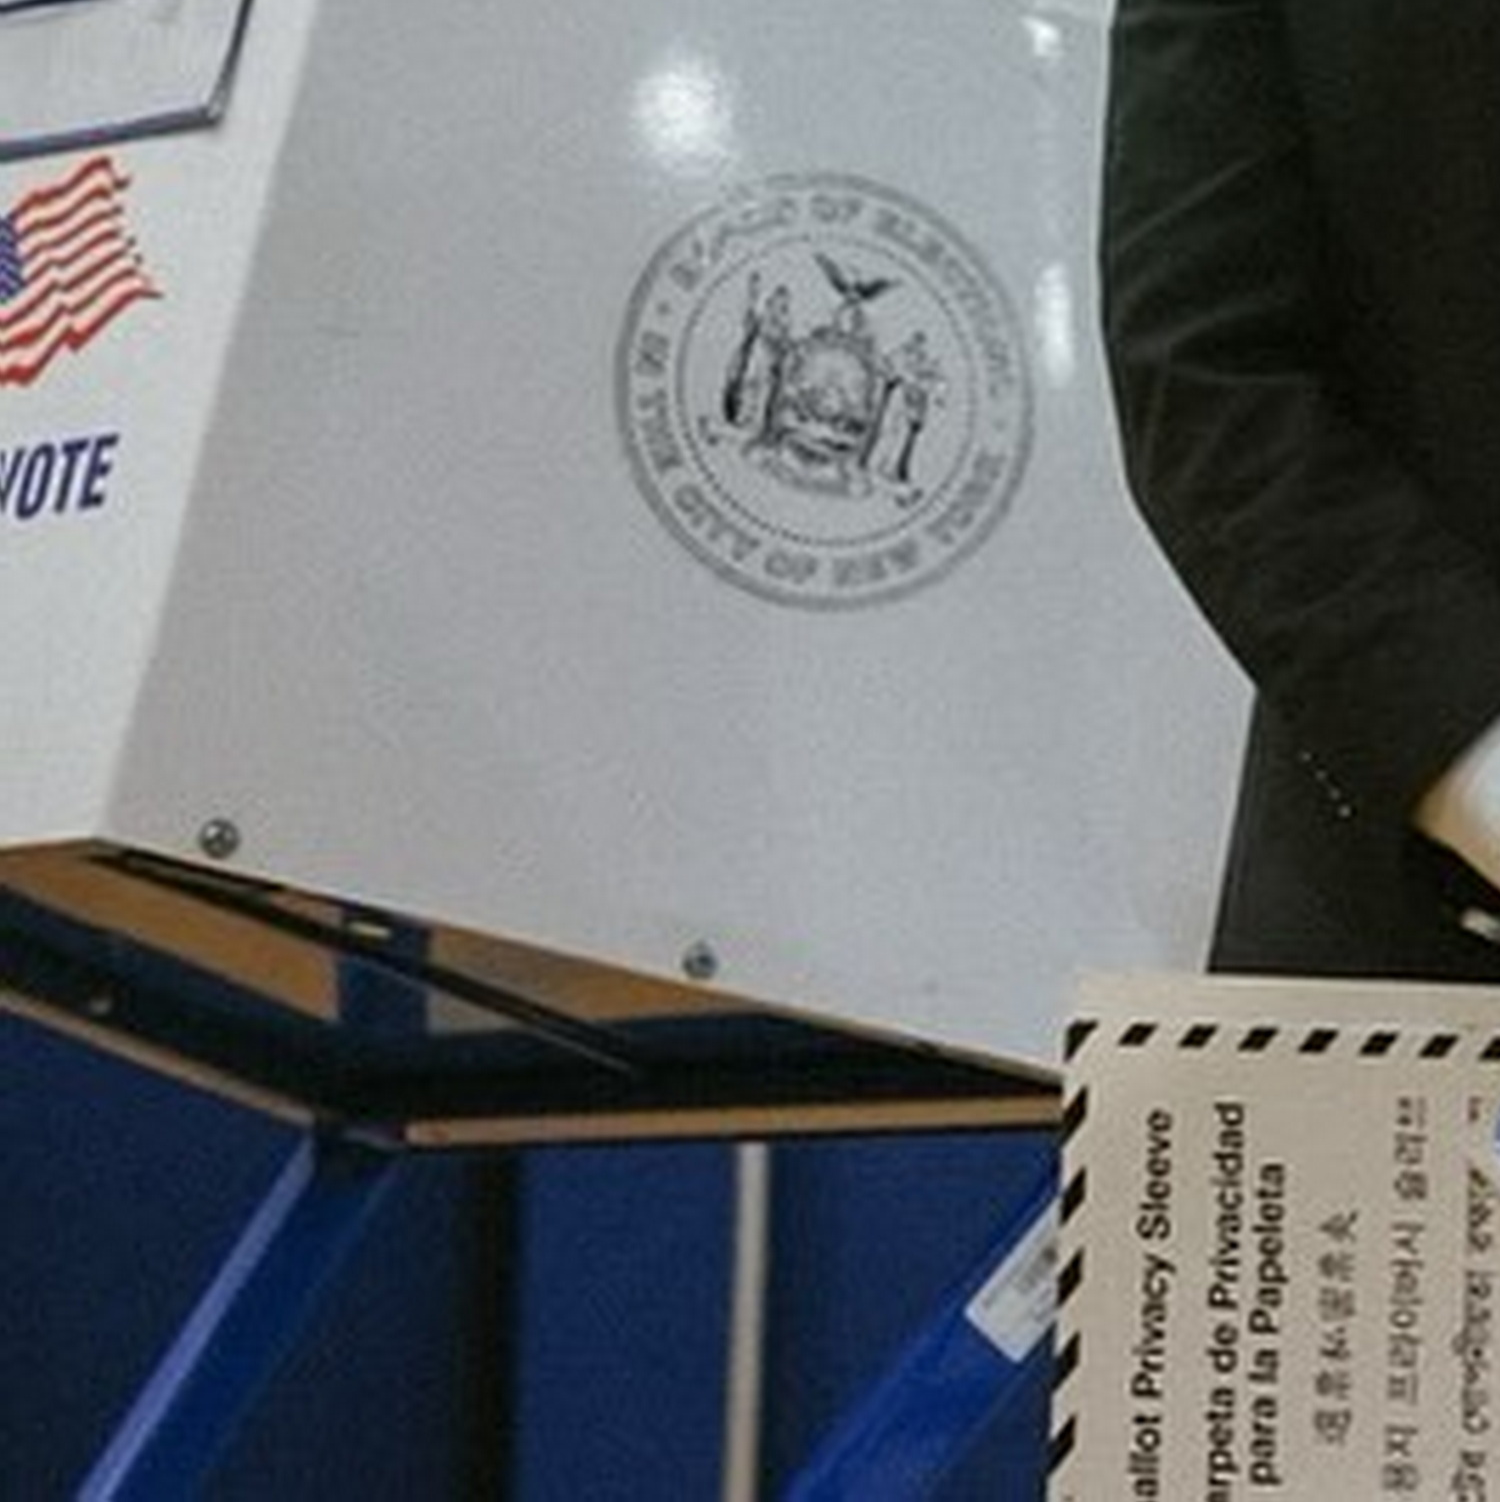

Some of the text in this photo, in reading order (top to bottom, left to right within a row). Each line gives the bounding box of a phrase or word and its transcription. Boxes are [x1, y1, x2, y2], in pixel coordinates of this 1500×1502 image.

[1207, 1102, 1244, 1310] Privacidad
[1393, 1097, 1427, 1200] 슬리브
[1128, 1110, 1176, 1502] allot Privacy Sleeve
[1206, 1323, 1238, 1374] de
[1247, 1164, 1289, 1485] para la Papeleta
[1387, 1222, 1426, 1405] 프라이버시
